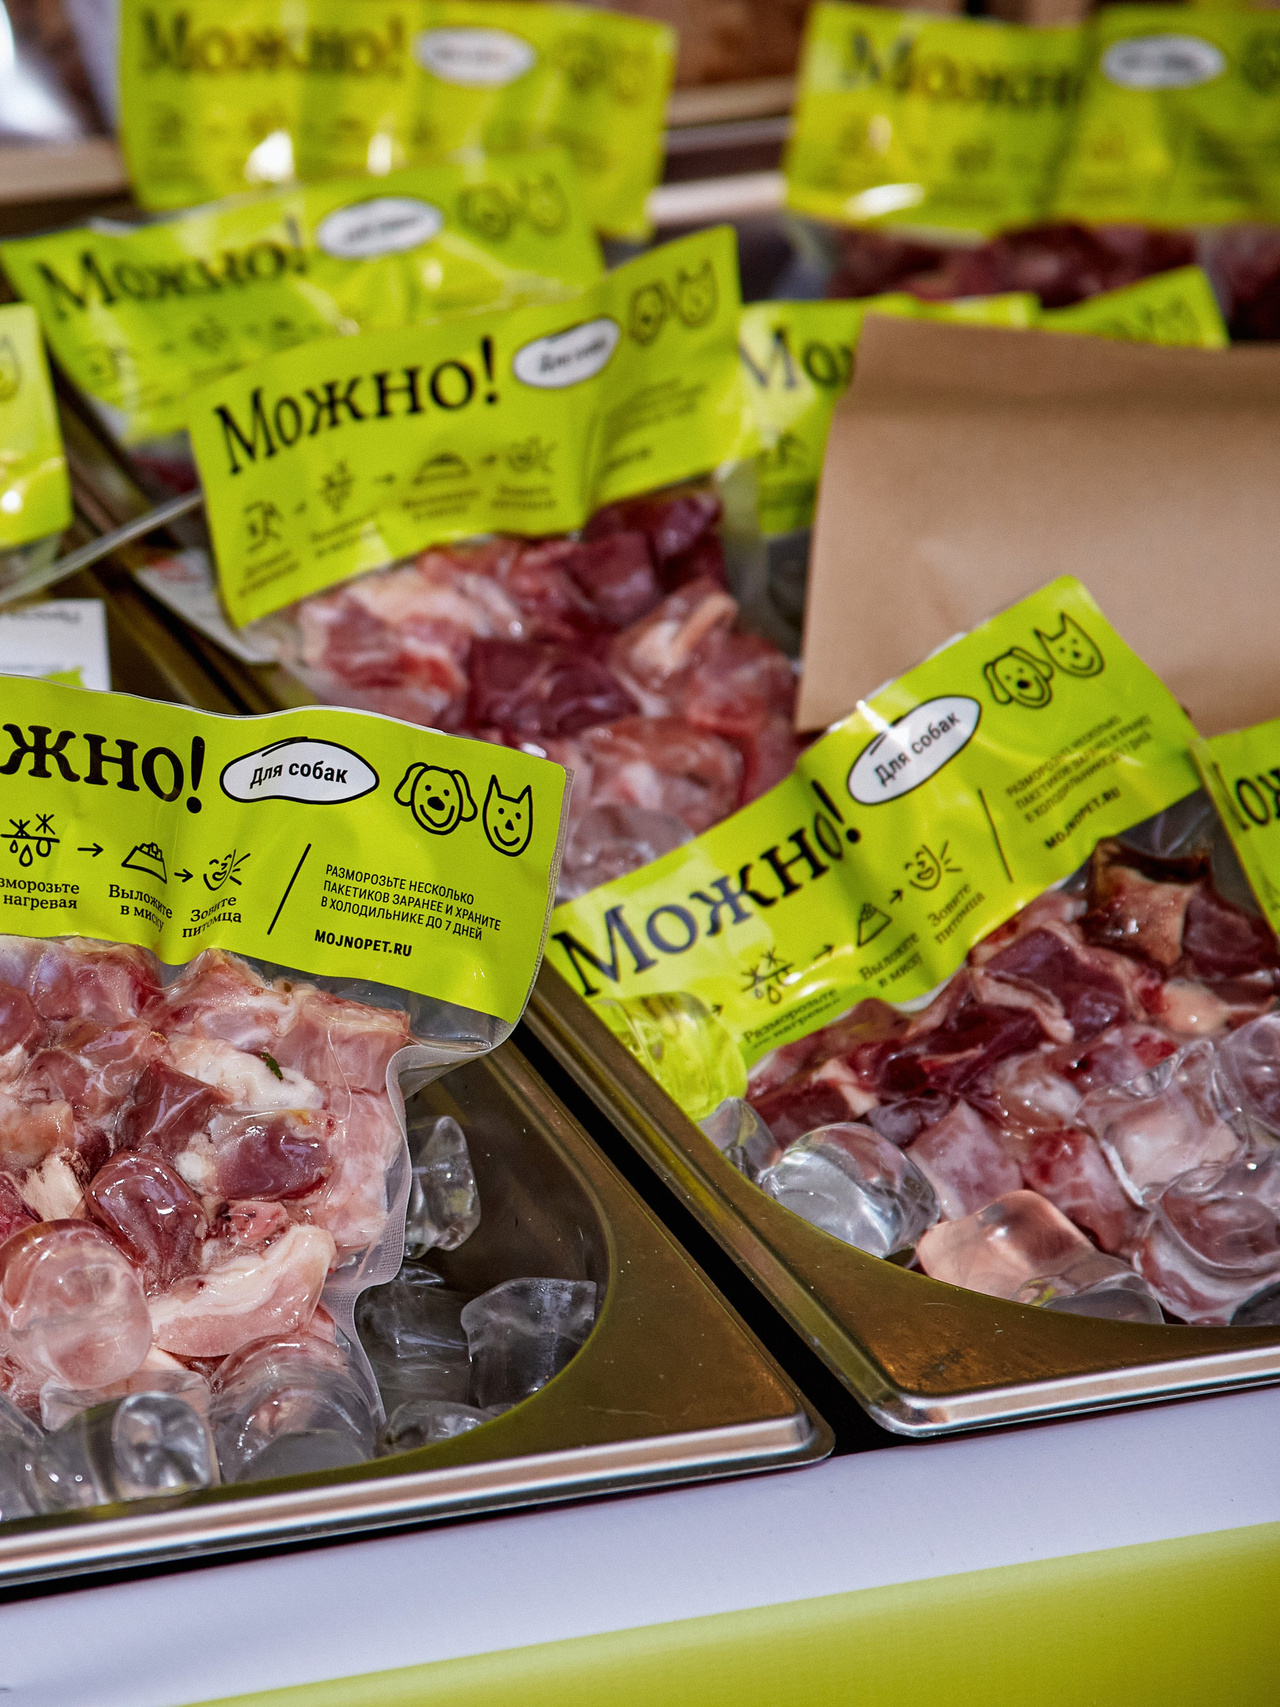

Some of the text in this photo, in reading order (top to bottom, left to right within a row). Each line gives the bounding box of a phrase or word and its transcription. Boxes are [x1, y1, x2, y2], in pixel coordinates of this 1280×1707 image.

[214, 335, 499, 475] Можно!
[874, 710, 961, 787] Для собак
[250, 759, 348, 790] Для собак
[2, 892, 78, 911] нагревая
[108, 884, 173, 919] Выложите
[323, 880, 501, 931] ПАКЕТИКОВ ЗАРАНЕЕ И ХРАНИТЕ
[325, 864, 475, 905] РАЗМОРОЗЬТЕ НЕСКОЛЬКО
[551, 779, 861, 996] Можно!
[927, 883, 973, 927] Зовите
[120, 905, 164, 933] в миску
[182, 911, 242, 938] питомца
[190, 896, 237, 922] Зовите
[321, 896, 483, 941] В ХОЛОДИЛЬНИКЕ ДО 7 ДНЕЙ
[935, 892, 986, 944] питомца
[314, 929, 412, 957] MOJNOPET.RU
[859, 932, 919, 982] Выложите
